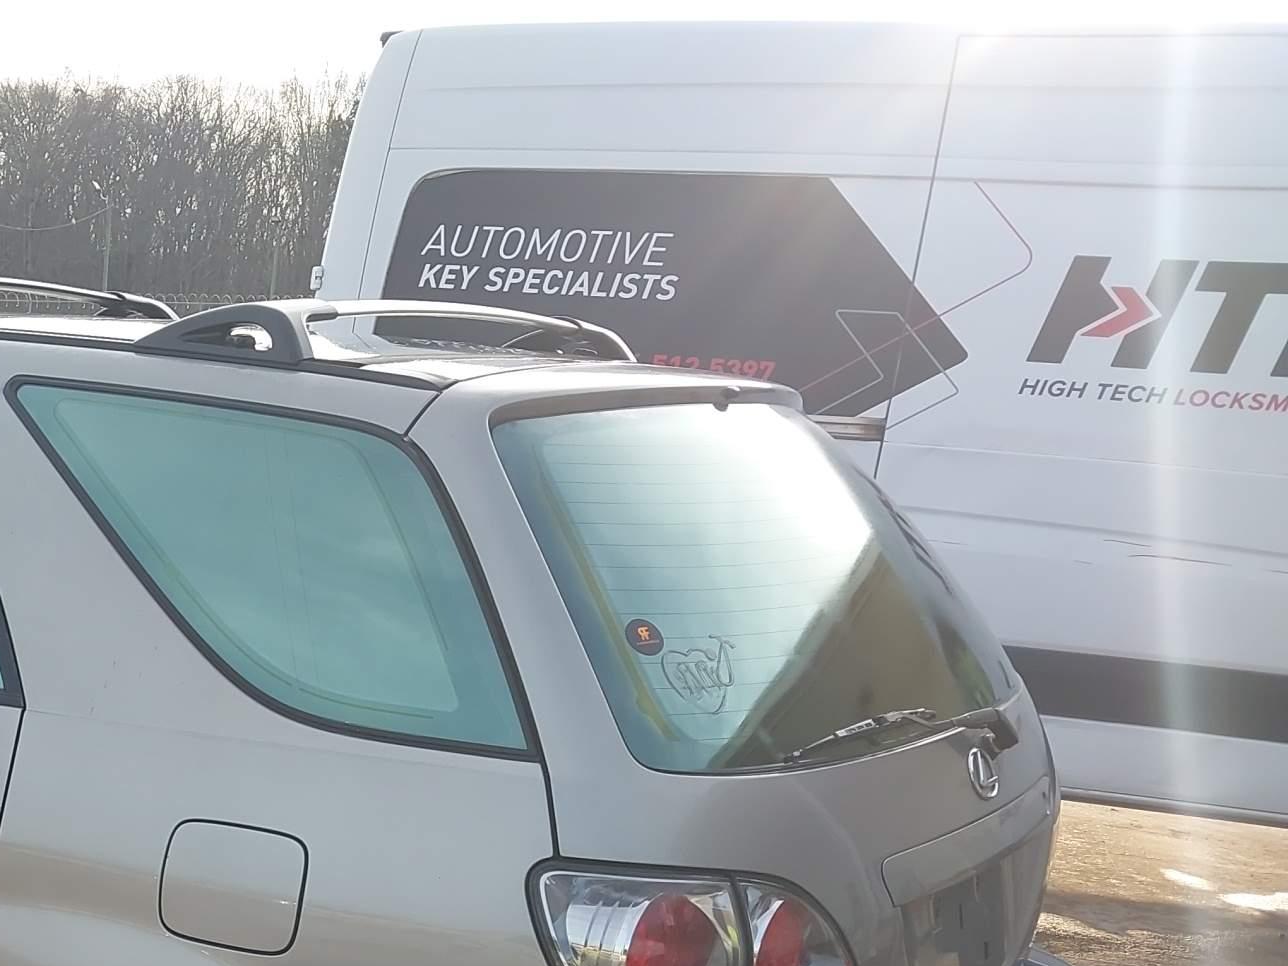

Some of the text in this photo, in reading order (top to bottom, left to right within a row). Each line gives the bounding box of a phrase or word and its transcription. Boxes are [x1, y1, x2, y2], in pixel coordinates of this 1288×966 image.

[420, 224, 675, 267] AUTOMOTIVE
[417, 262, 680, 301] KEY SPECIALISTS
[1025, 254, 1288, 378] HT
[1018, 378, 1089, 399] HIGH
[1096, 382, 1168, 404] TECH
